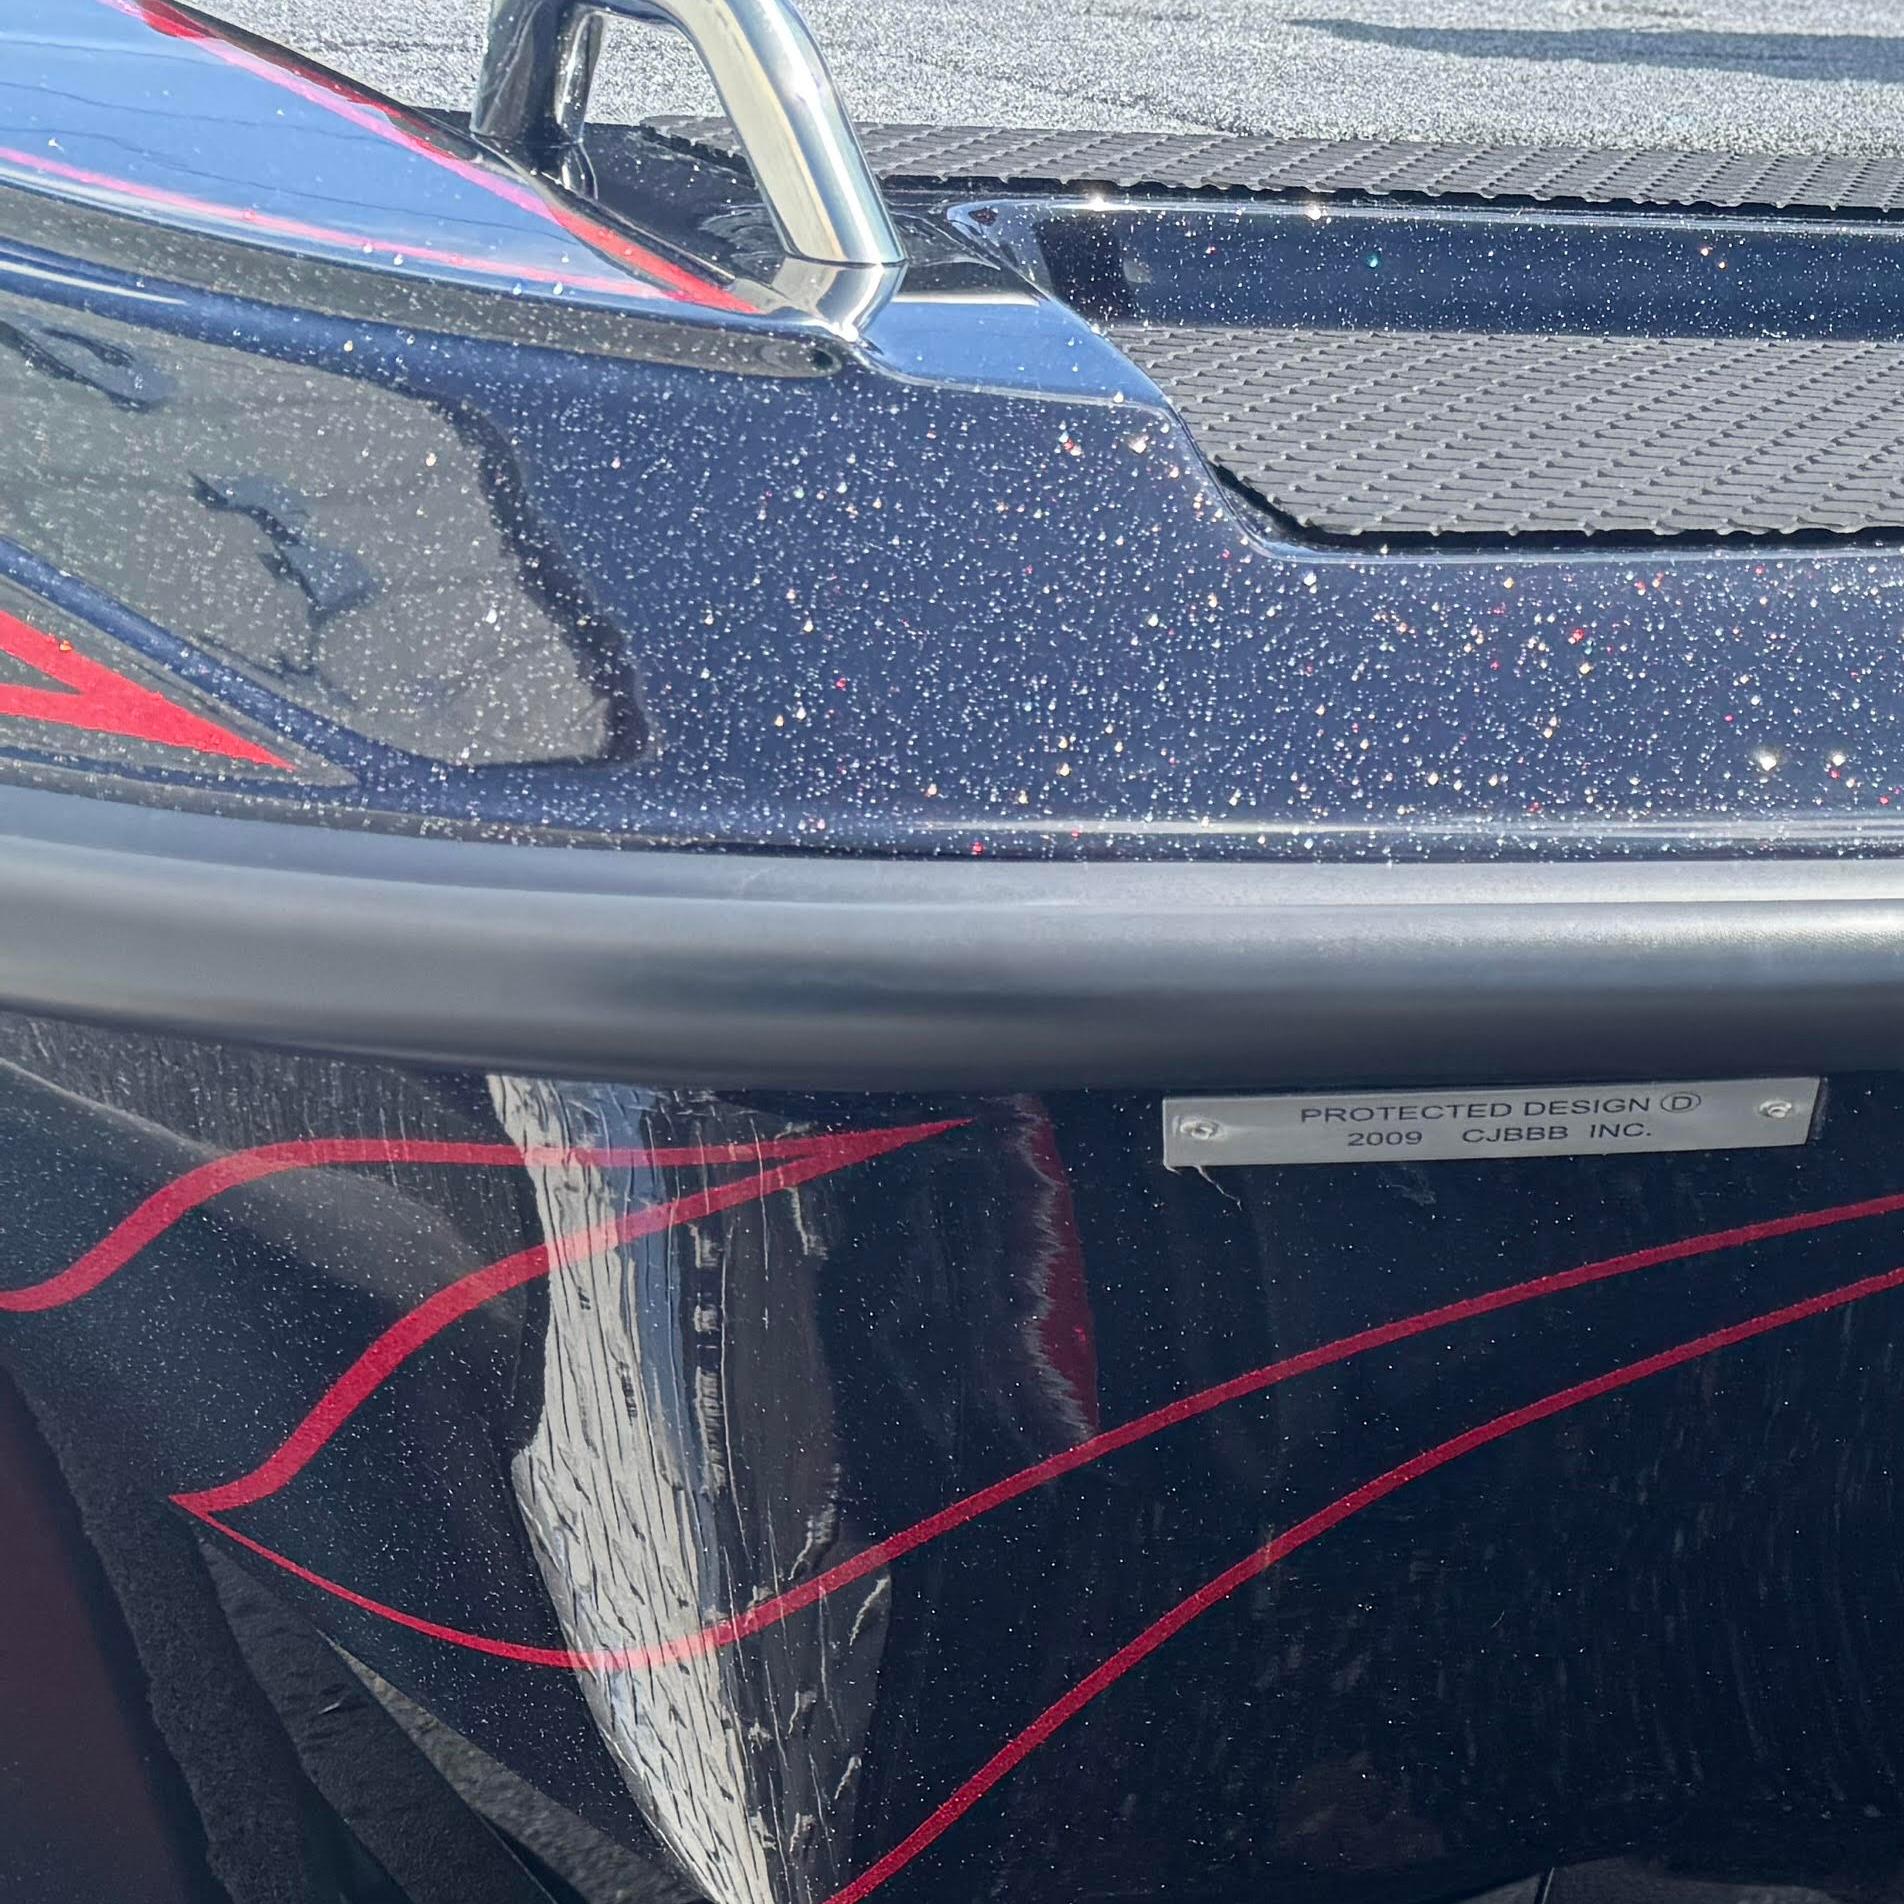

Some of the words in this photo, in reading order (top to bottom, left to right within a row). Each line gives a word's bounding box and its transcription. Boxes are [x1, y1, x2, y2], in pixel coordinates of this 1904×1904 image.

[1301, 1103, 1513, 1123] PROTECTED
[1524, 1097, 1650, 1116] DESIGN
[1348, 1131, 1423, 1147] 2009
[1462, 1126, 1569, 1143] CJBBB
[1590, 1123, 1652, 1138] INC.
